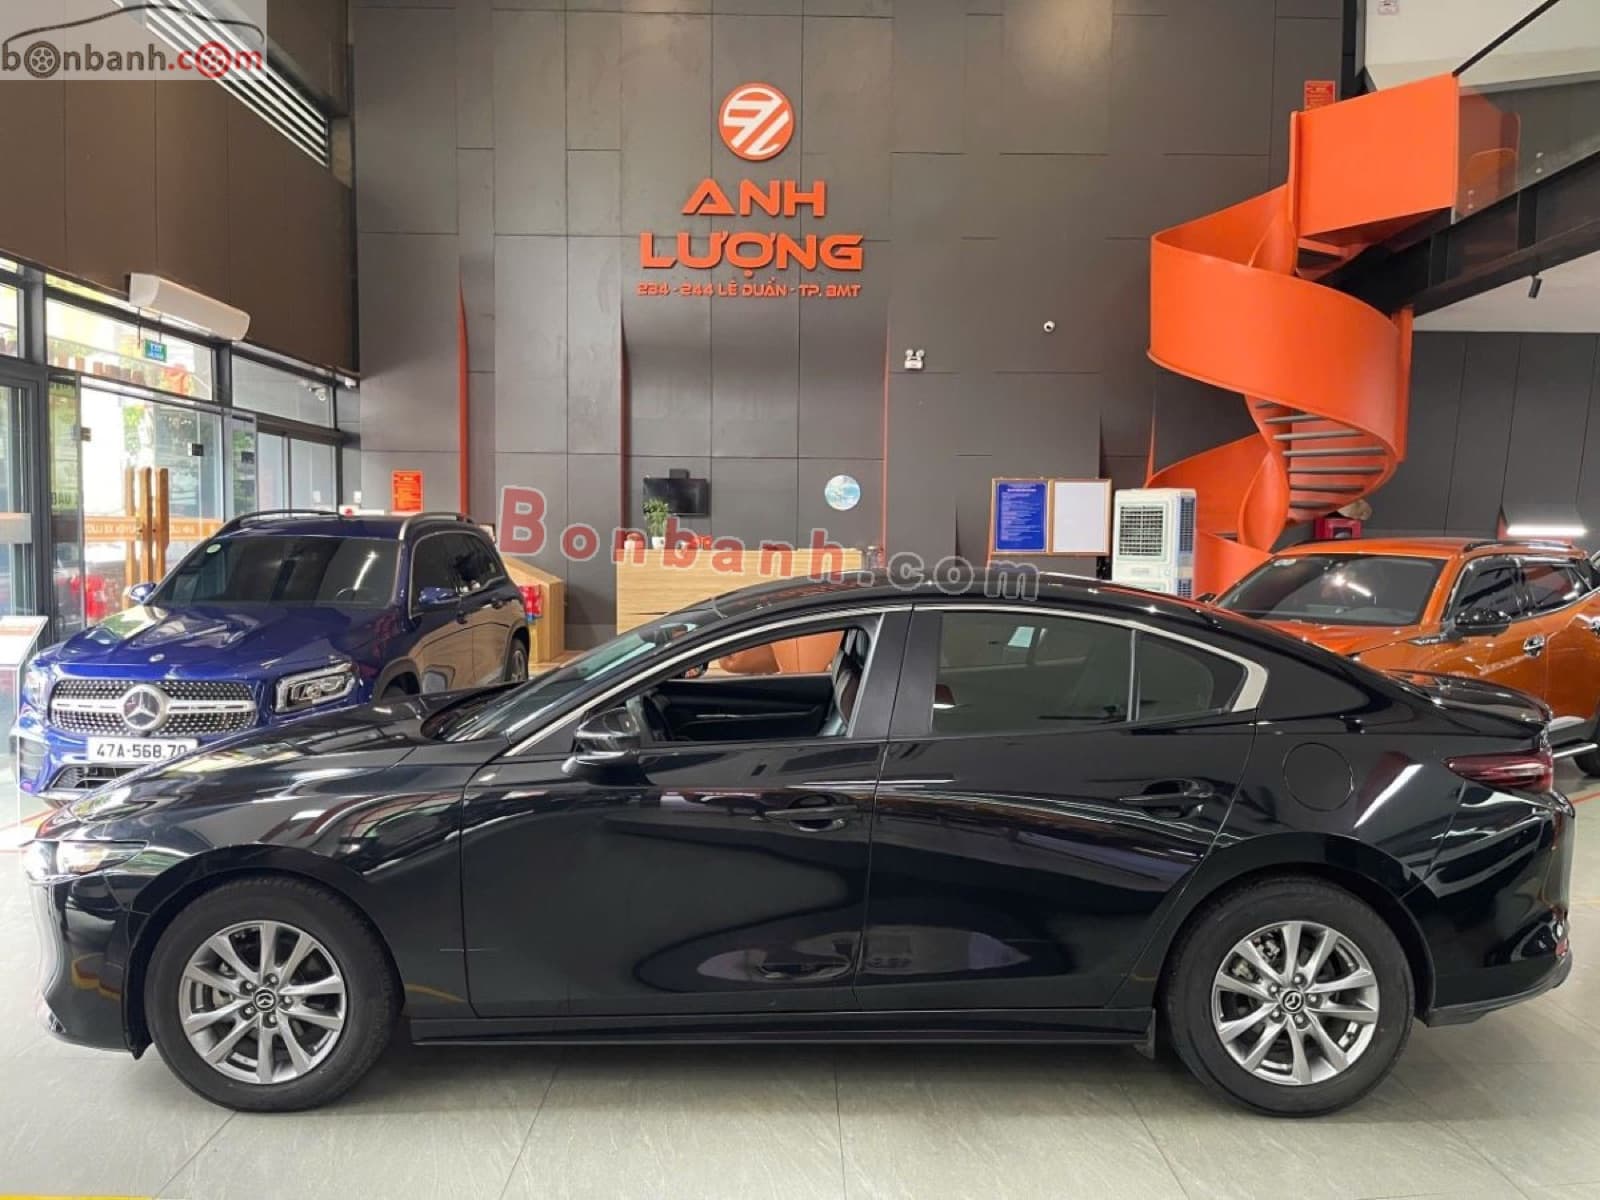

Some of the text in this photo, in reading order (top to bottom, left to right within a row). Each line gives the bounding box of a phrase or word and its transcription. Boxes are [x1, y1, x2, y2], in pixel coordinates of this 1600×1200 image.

[681, 177, 826, 216] ANH
[639, 231, 863, 278] LƯỢNG
[637, 282, 669, 297] 234
[680, 282, 714, 297] 244
[717, 279, 738, 297] LÊ
[798, 284, 822, 297] TP.
